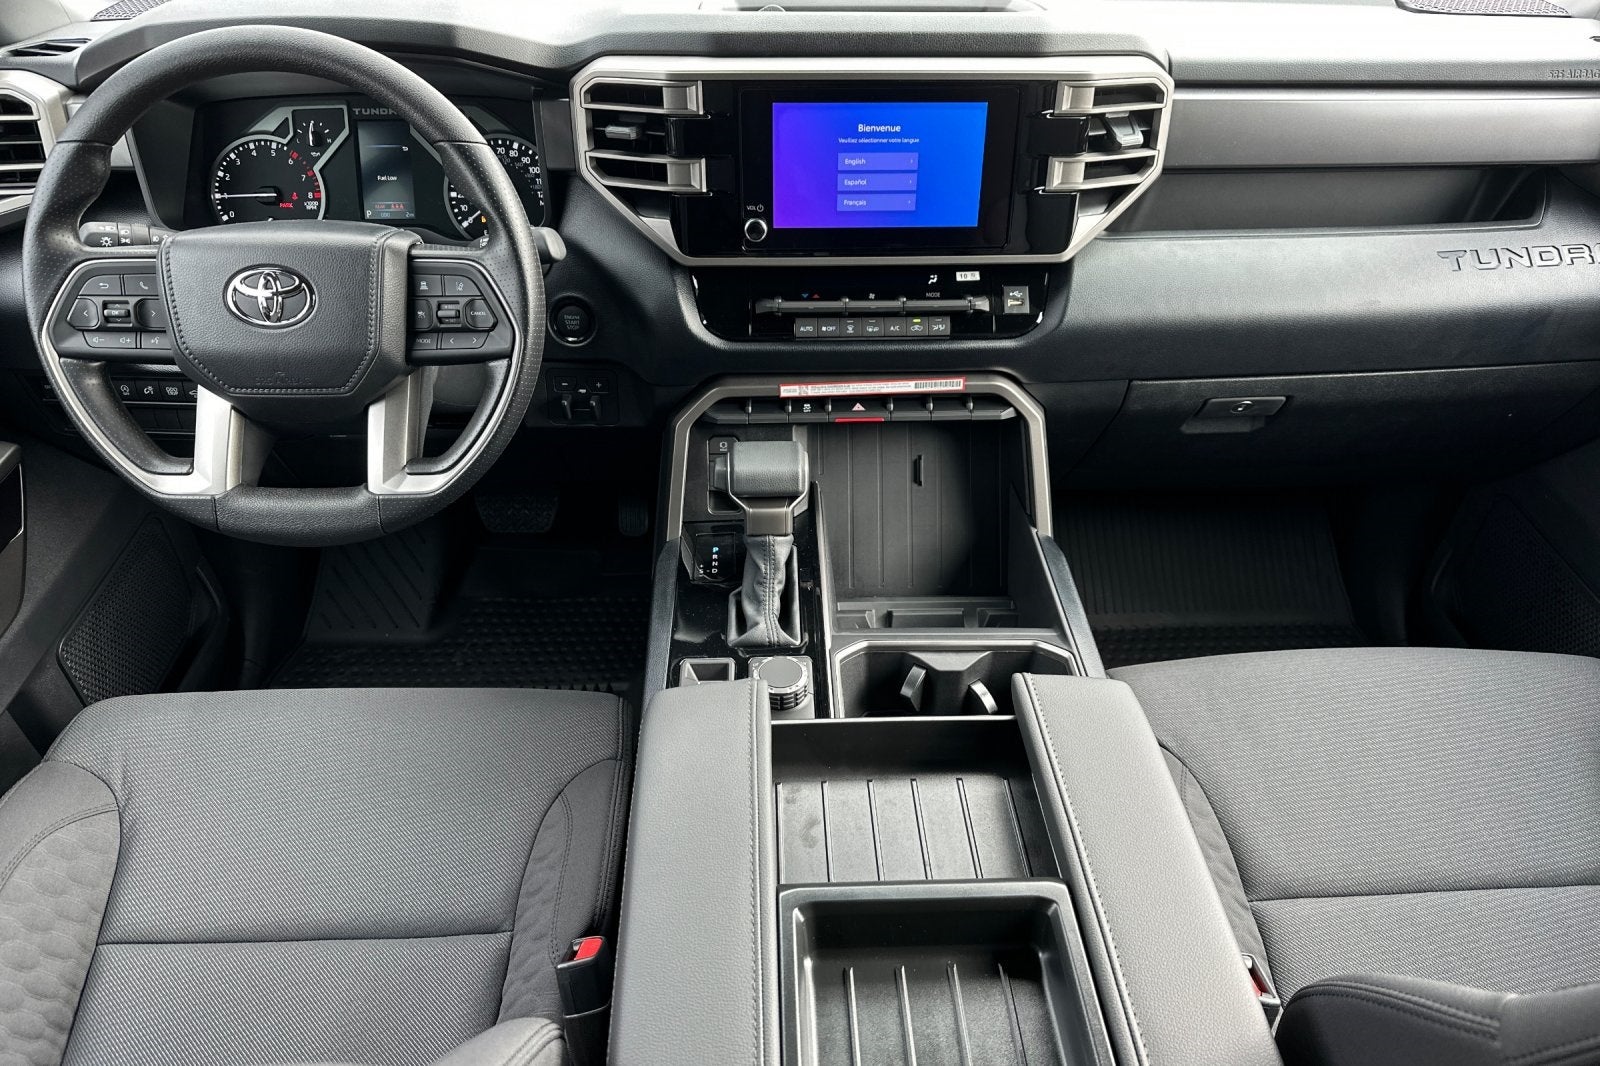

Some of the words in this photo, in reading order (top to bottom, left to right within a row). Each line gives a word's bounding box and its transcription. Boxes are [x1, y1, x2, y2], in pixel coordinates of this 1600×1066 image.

[857, 123, 901, 133] Bienvenue
[902, 137, 920, 145] langue
[496, 147, 505, 155] 70
[521, 156, 531, 164] 90
[844, 158, 866, 166] English
[528, 166, 540, 174] 100
[844, 178, 867, 186] Español
[843, 199, 867, 207] Français
[460, 204, 468, 212] 10
[1437, 242, 1600, 272] TUNDR
